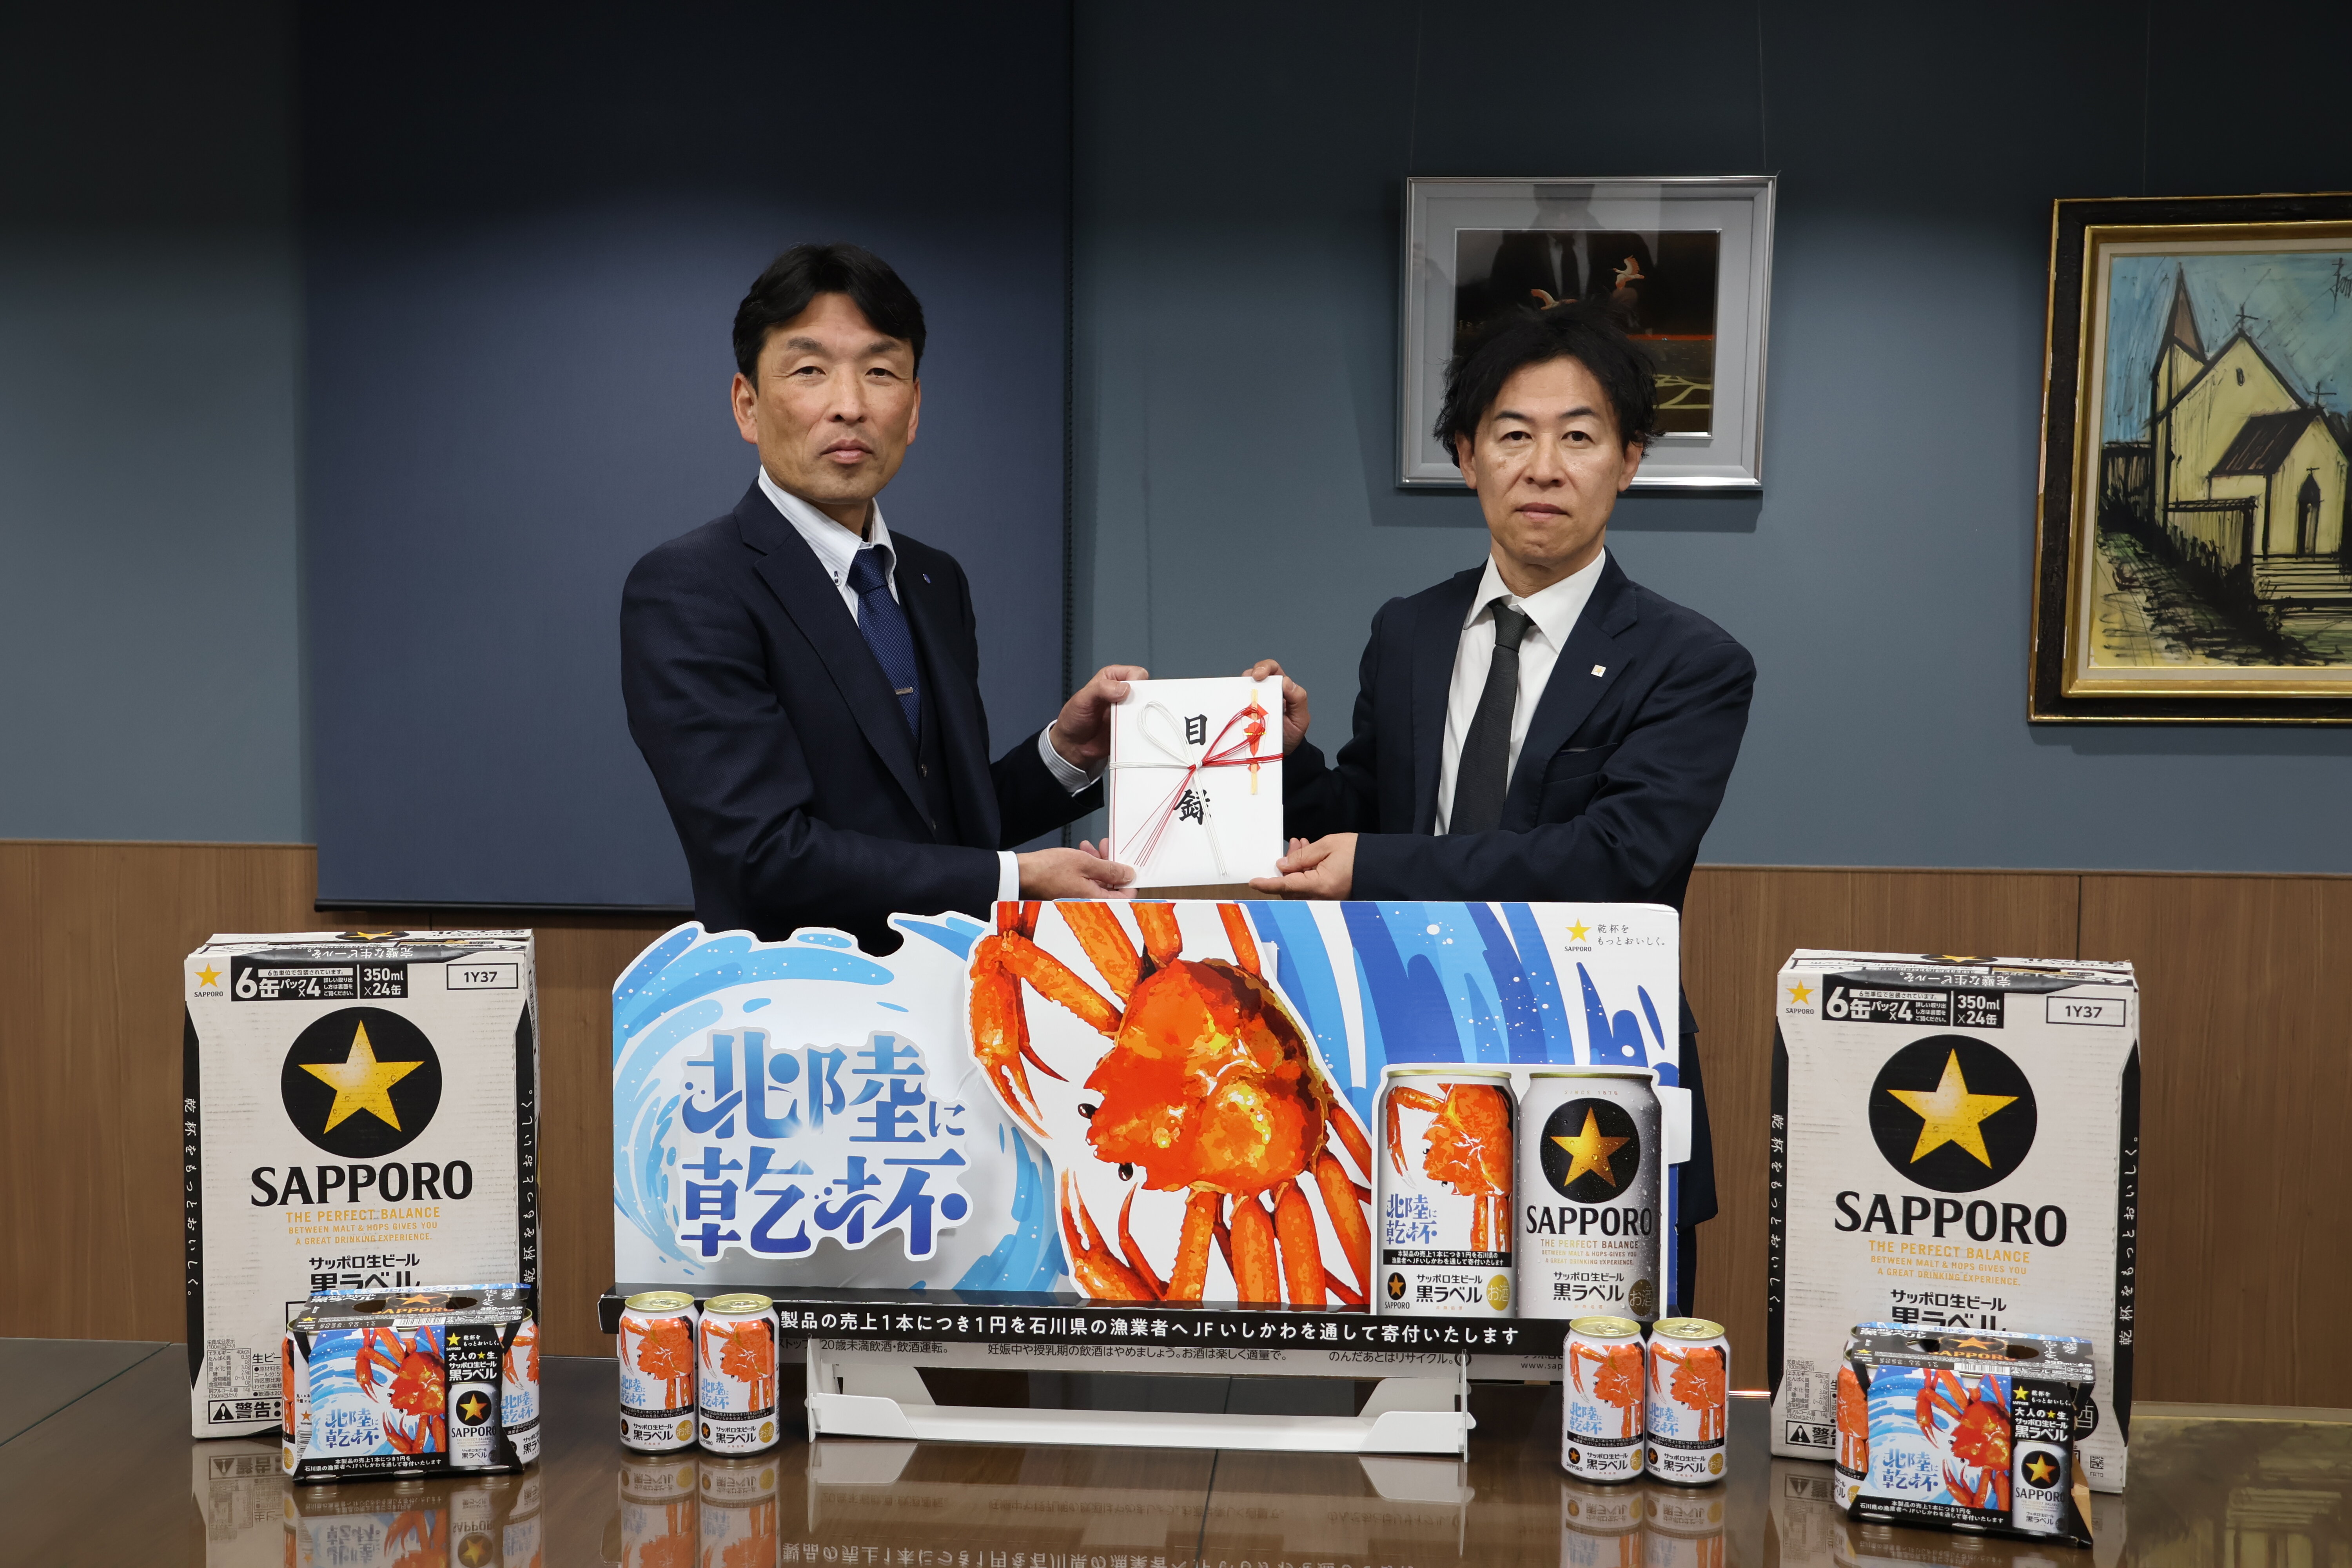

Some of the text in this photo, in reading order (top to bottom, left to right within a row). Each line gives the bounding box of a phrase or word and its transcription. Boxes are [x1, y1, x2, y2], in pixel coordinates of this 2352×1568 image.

[1173, 714, 1211, 825] 目録
[1597, 924, 1629, 933] 乾杯を
[1597, 936, 1665, 946] もっとおいしく。
[308, 947, 413, 959] 完璧な生ビールを。
[364, 968, 403, 981] 350ml
[464, 971, 497, 983] 1Y37
[1900, 972, 2011, 987] 完璧な生ビールを。
[1859, 991, 1937, 1000] 6缶単位で包装されています。
[1958, 995, 1999, 1010] 350ml
[2065, 1005, 2102, 1018] 1Y37
[682, 1031, 965, 1143] 北陸に
[251, 1160, 473, 1207] SAPPORO
[521, 1089, 537, 1283] 乾杯をもっとおいしく。
[184, 1098, 198, 1296] 乾杯をもっとおいしく。
[681, 1145, 967, 1257] 乾杯
[1387, 1194, 1437, 1219] 北陸に
[1769, 1113, 1784, 1312] 乾杯をもっとおいしく。
[286, 1207, 440, 1223] THE PERFECT BALANCE
[1526, 1205, 1652, 1236] SAPPORO
[1835, 1191, 2067, 1247] SAPPORO
[289, 1226, 329, 1234] BETWEEN
[1386, 1220, 1437, 1245] 乾杯
[335, 1235, 376, 1243] DRINKING
[378, 1233, 432, 1242] EXPERIENCE.
[1541, 1239, 1639, 1249] THE PERFECT BALANCE
[2119, 1137, 2138, 1345] 乾杯をもっとおいしく。
[1397, 1250, 1497, 1259] 本製品の売上1本につき1円を石川県の
[1868, 1240, 2030, 1263] THE PERFECT BALANCE
[309, 1253, 420, 1270] サッポロ生ビール
[1392, 1257, 1503, 1266] 漁業者へJFいしかわを通して寄付いたします
[1871, 1256, 1912, 1266] BETWEEN
[1916, 1259, 1939, 1268] MALT
[1951, 1262, 1975, 1271] HOPS
[1979, 1264, 2005, 1273] GIVES
[2009, 1266, 2027, 1274] YOU
[310, 1271, 420, 1293] 黒ラベル
[1416, 1274, 1483, 1283] サッポロ生ビール
[1553, 1271, 1624, 1281] サッポロ生ビール
[1887, 1269, 1914, 1277] GREAT
[1918, 1271, 1960, 1281] DRINKING
[1963, 1274, 2020, 1286] EXPERIENCE.
[1416, 1285, 1483, 1303] 黒ラベル
[1487, 1285, 1509, 1301] お酒
[1553, 1283, 1624, 1301] 黒ラベル
[1890, 1289, 2007, 1312] サッポロ生ビール
[1892, 1306, 2006, 1332] 黒ラベル
[1860, 1330, 1926, 1338] 黒ラベル
[821, 1339, 948, 1354] 20歳未満飲酒・飲酒運転。
[1329, 1351, 1453, 1365] のんだあとはリサイクル。
[448, 1361, 497, 1369] サッポロ生ビール
[449, 1368, 497, 1381] 黒ラベル
[2031, 1397, 2071, 1406] もっとおいしく。
[325, 1407, 379, 1428] 北陸に
[2014, 1418, 2068, 1429] サッポロ生ビール
[325, 1427, 379, 1448] 乾杯
[451, 1426, 497, 1438] SAPPORO
[633, 1429, 673, 1441] 黒ラベル
[716, 1433, 756, 1444] 黒ラベル
[2014, 1425, 2068, 1441] 黒ラベル
[335, 1455, 411, 1464] 本製品の売上1本につき1円を
[1586, 1459, 1628, 1470] 黒ラベル
[1664, 1453, 1706, 1462] サッポロ生ビール
[1883, 1448, 1938, 1472] 北陸に
[304, 1459, 442, 1472] 石川県の漁業者へJFいしかわを通して寄付いたします
[1664, 1459, 1706, 1473] 黒ラベル
[1883, 1468, 1939, 1492] 乾杯
[2015, 1487, 2064, 1503] SAPPORO
[1860, 1502, 2004, 1524] 石川県の漁業者へJFいしかわを通して寄付いたします
[1891, 1501, 1972, 1514] 本製品の売上1本につき1円を
[2026, 1515, 2054, 1525] 黒ラベル
